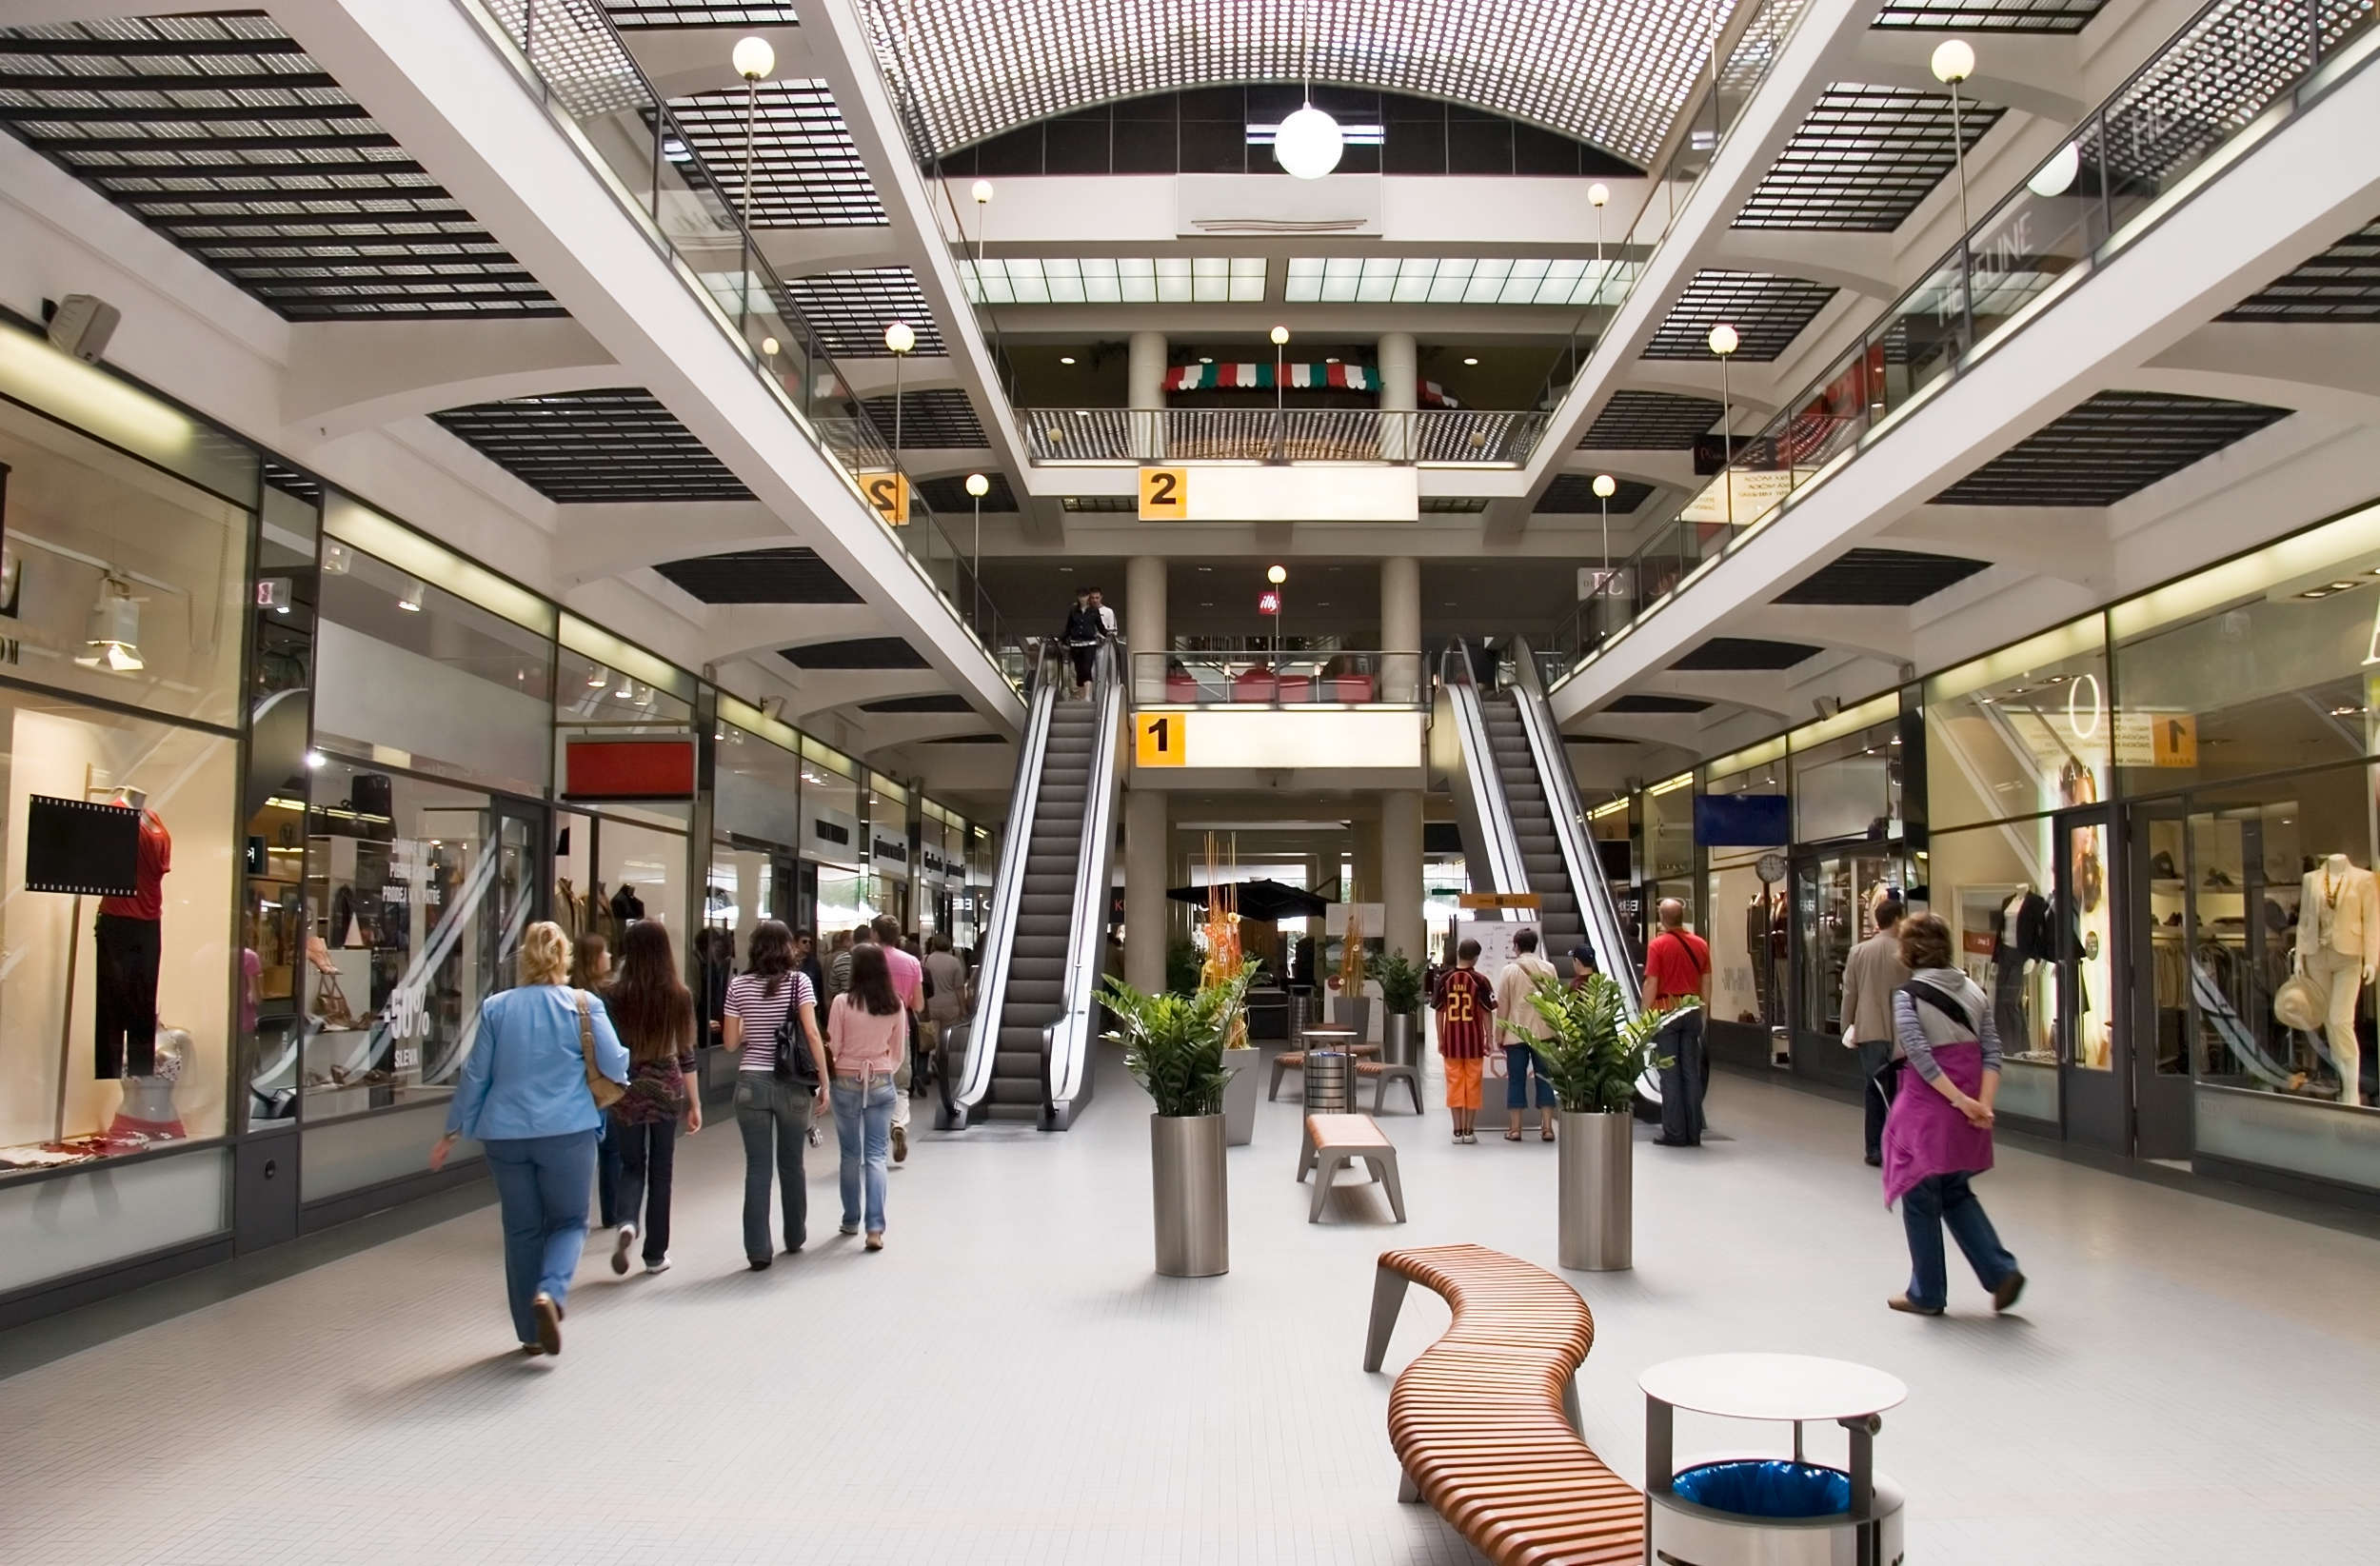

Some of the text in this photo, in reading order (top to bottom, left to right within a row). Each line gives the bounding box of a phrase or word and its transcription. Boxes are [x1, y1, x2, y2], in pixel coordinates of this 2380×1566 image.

[1149, 472, 1177, 505] 2
[1147, 718, 1168, 752] 1
[1448, 992, 1474, 1021] 22
